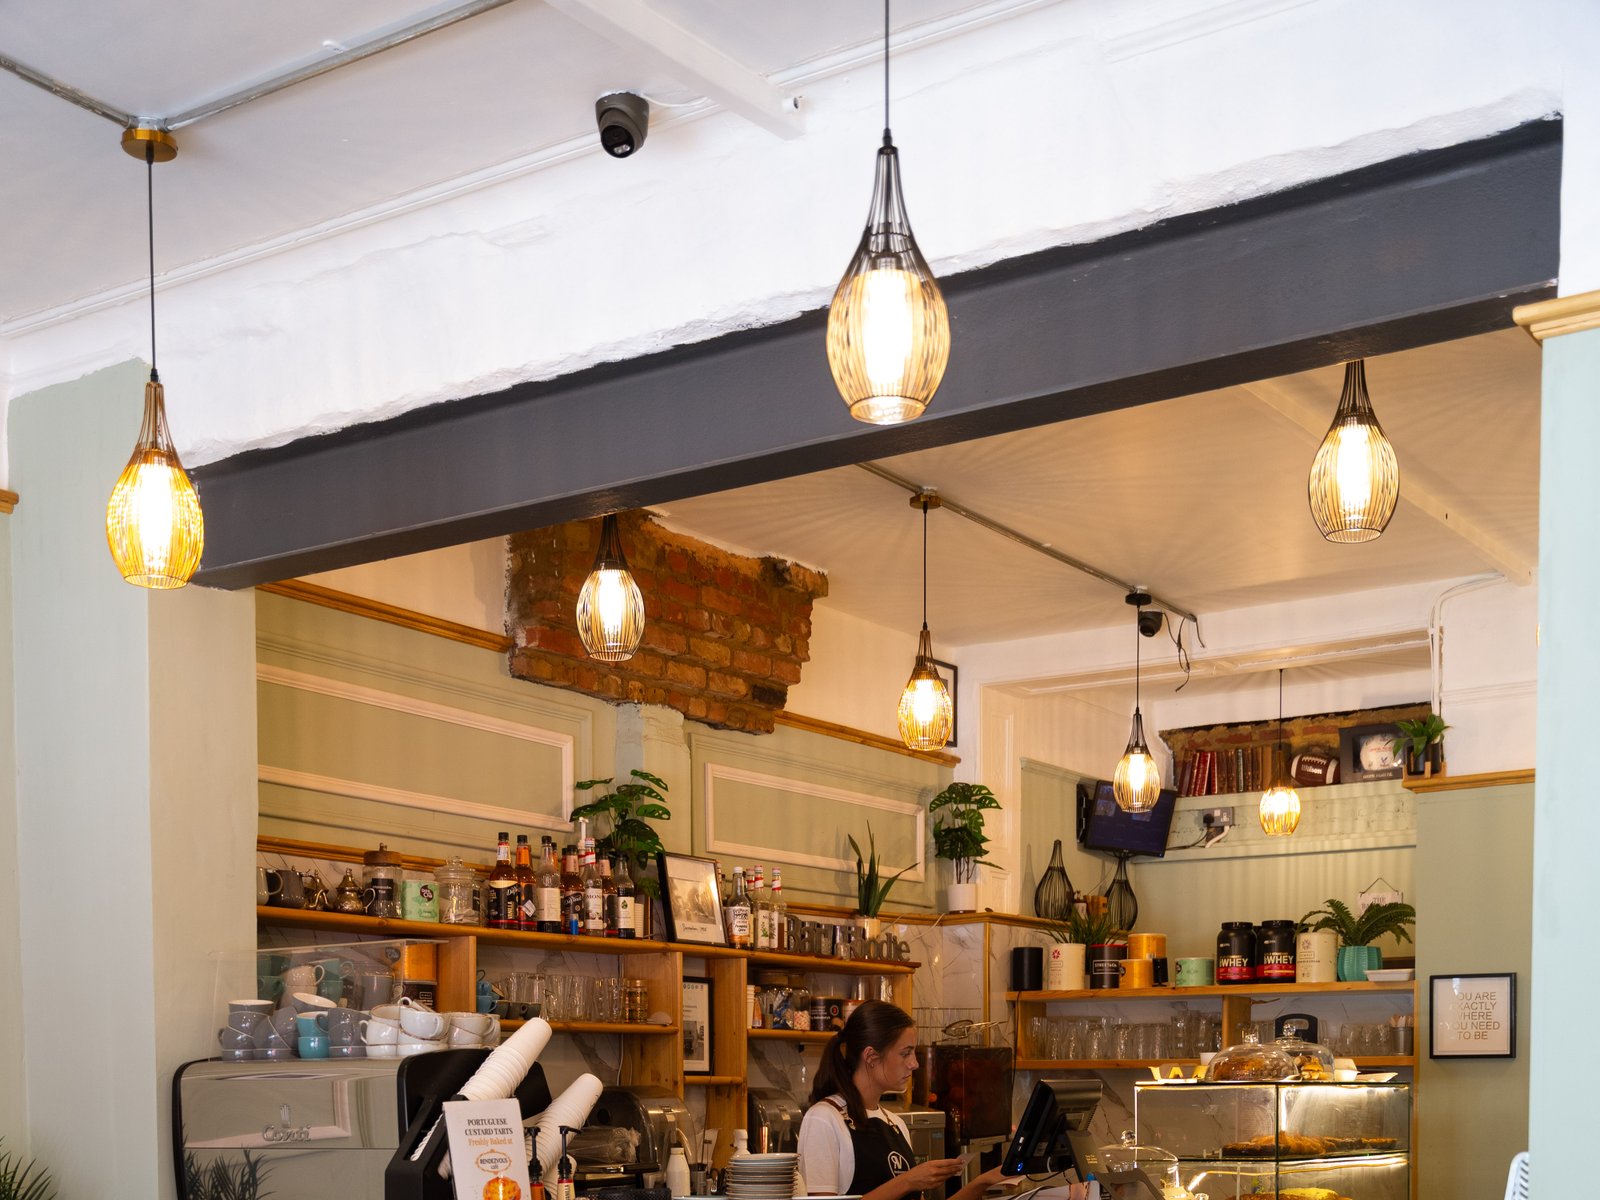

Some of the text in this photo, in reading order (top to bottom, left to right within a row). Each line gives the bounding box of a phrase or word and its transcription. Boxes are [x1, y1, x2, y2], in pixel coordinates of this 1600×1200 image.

[1222, 958, 1248, 967] WHEY
[1266, 955, 1294, 964] WHEY
[1474, 992, 1496, 1001] ARE
[1470, 1021, 1500, 1030] NEED
[1457, 1031, 1488, 1040] TO BE
[467, 1118, 508, 1126] PORTUGUESE
[465, 1127, 513, 1136] CUSTARD TARTS
[468, 1137, 489, 1147] Freshly
